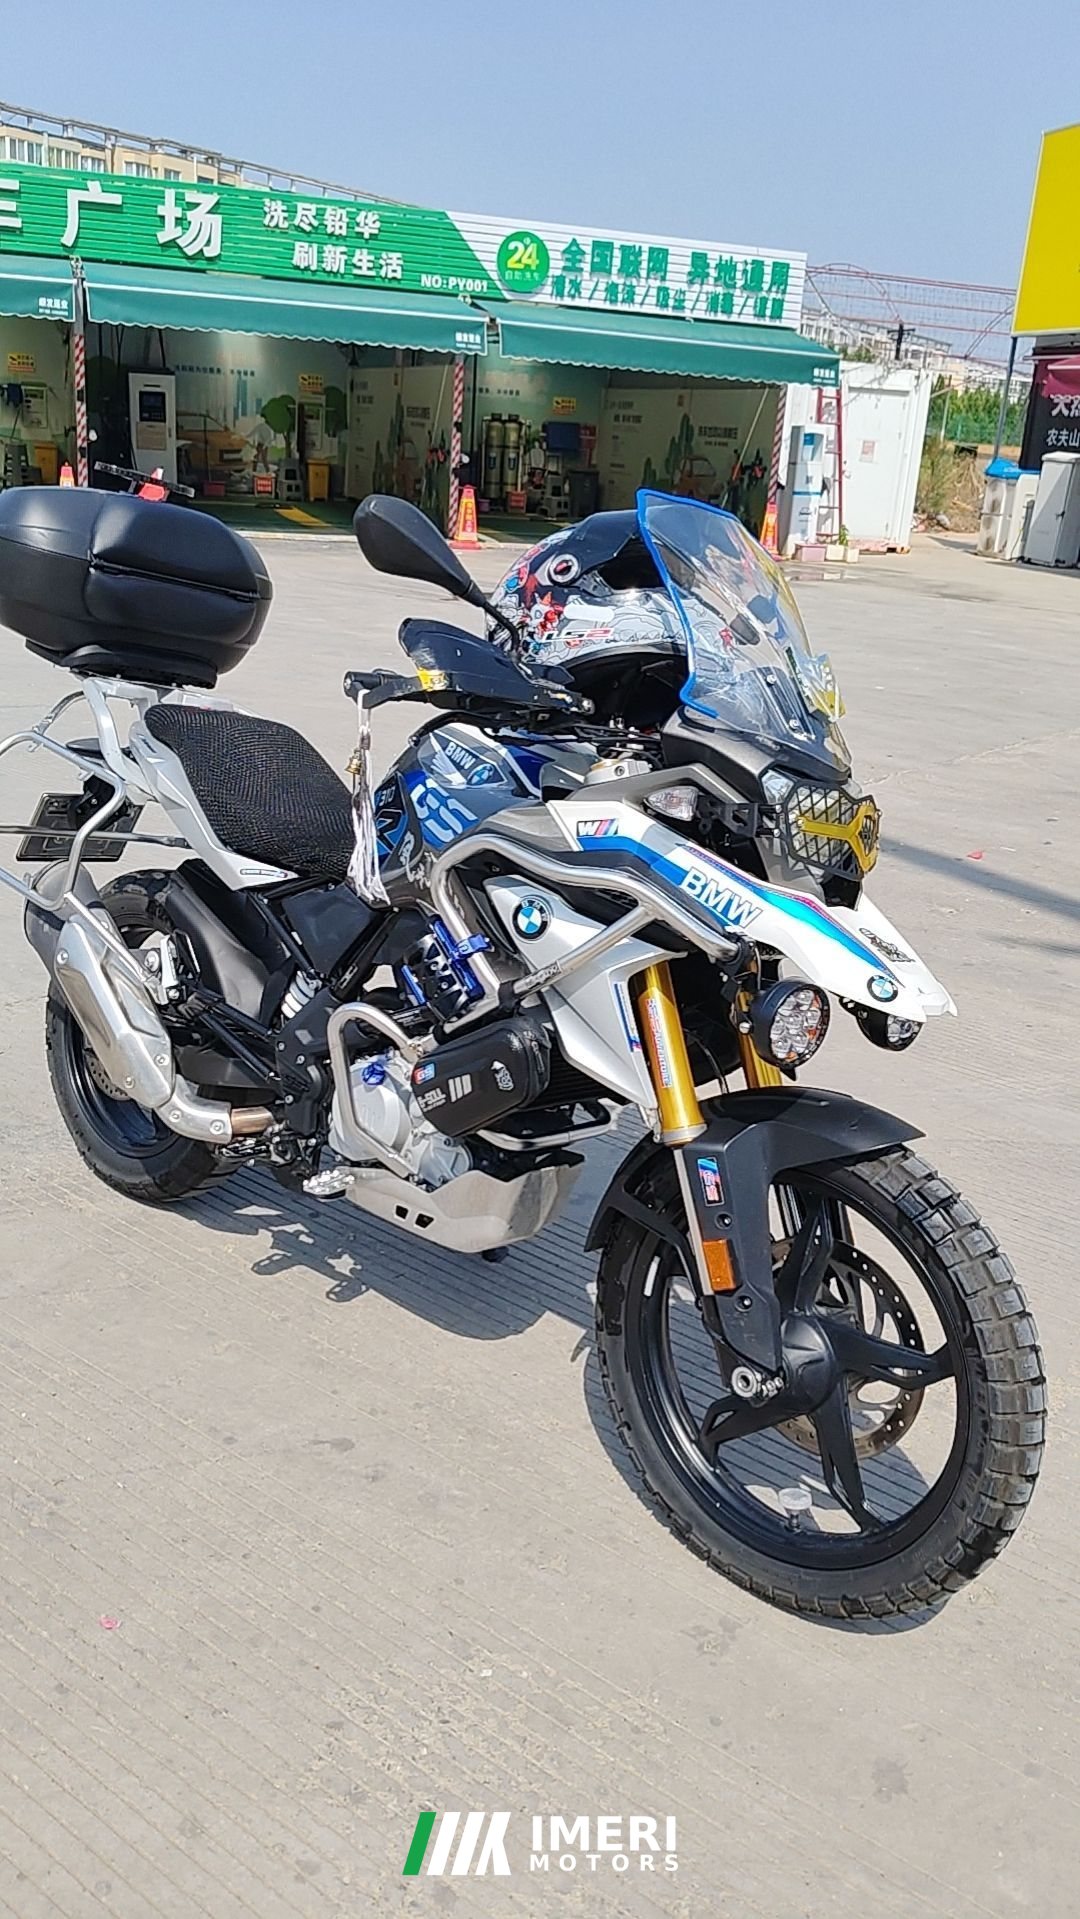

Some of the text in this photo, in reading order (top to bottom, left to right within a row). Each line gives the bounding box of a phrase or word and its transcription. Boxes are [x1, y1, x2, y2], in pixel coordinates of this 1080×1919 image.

[263, 198, 381, 239] 洗尽铅华
[292, 241, 403, 280] 刷新生活
[507, 240, 540, 270] 24
[561, 238, 791, 294] 全国联网 异地通用
[420, 274, 489, 293] NO:PY001
[543, 627, 614, 643] LS2
[444, 741, 477, 770] BMW
[679, 866, 763, 928] BMW
